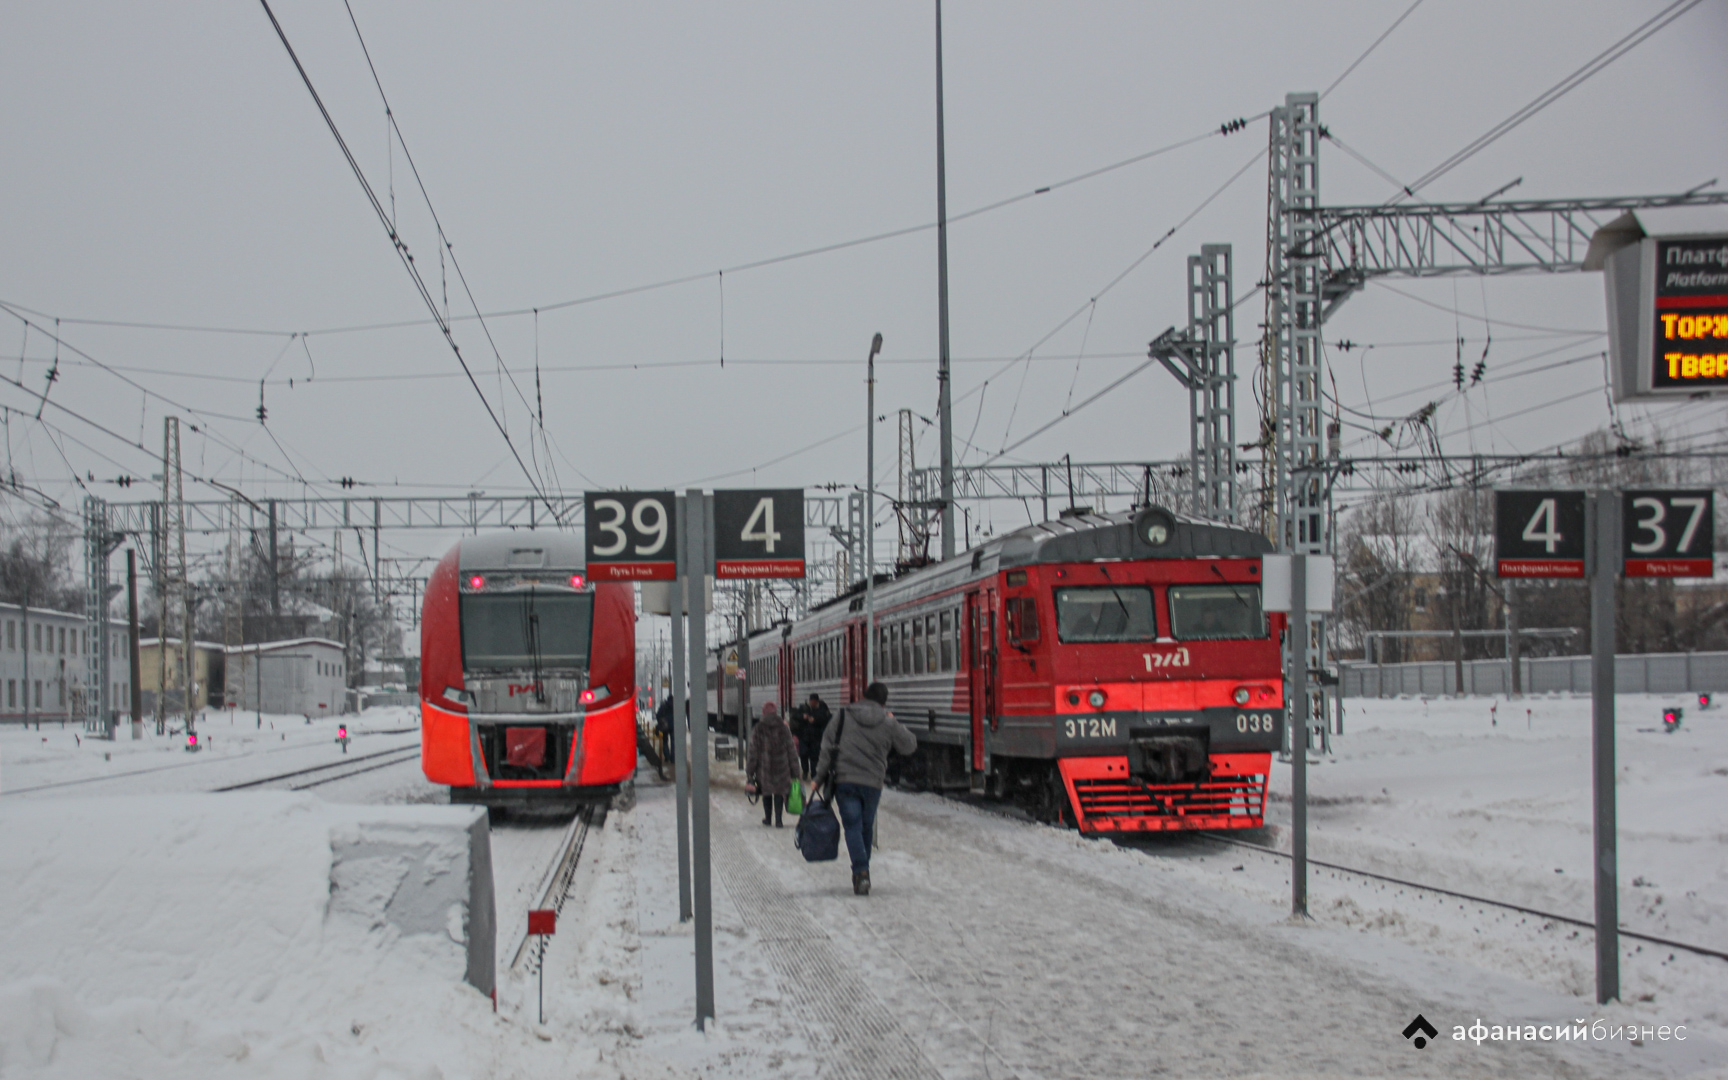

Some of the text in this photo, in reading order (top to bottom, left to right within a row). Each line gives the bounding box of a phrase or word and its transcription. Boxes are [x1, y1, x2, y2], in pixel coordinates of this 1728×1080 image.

[593, 498, 668, 556] 39
[741, 497, 781, 553] 4
[1522, 498, 1561, 553] 4
[1631, 497, 1706, 553] 37
[610, 567, 630, 577] Путь
[721, 564, 769, 575] Платформа
[1501, 564, 1549, 574] Платформа
[1236, 713, 1273, 733] 038
